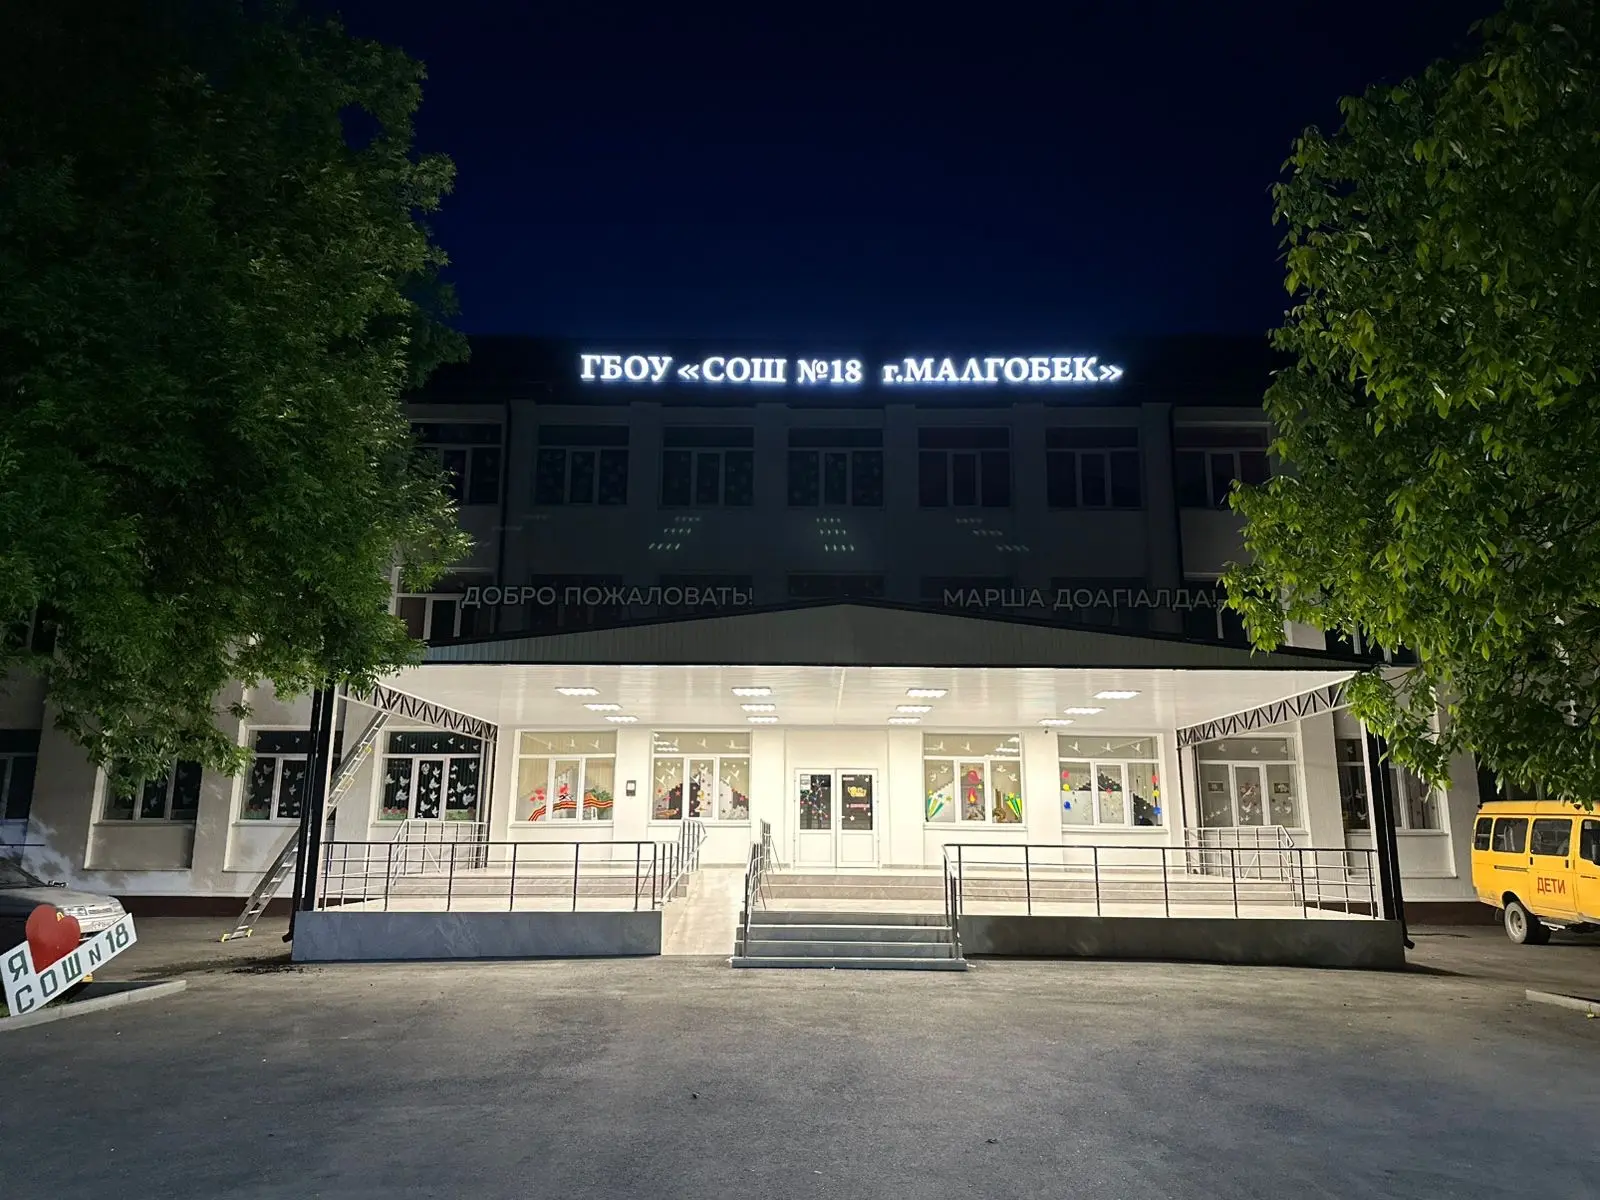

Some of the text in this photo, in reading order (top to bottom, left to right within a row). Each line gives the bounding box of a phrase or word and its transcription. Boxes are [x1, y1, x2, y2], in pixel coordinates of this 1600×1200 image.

[580, 355, 673, 382] ГБОУ
[677, 357, 787, 383] «СОШ
[797, 359, 862, 383] №18
[461, 586, 753, 609] ДОБРО ПОЖАЛОВАТЬ!
[943, 588, 1045, 608] МАРША
[1537, 876, 1566, 894] ДЕТИ
[8, 949, 29, 982] Я
[15, 952, 82, 1014] СОШ
[105, 923, 129, 954] 18
